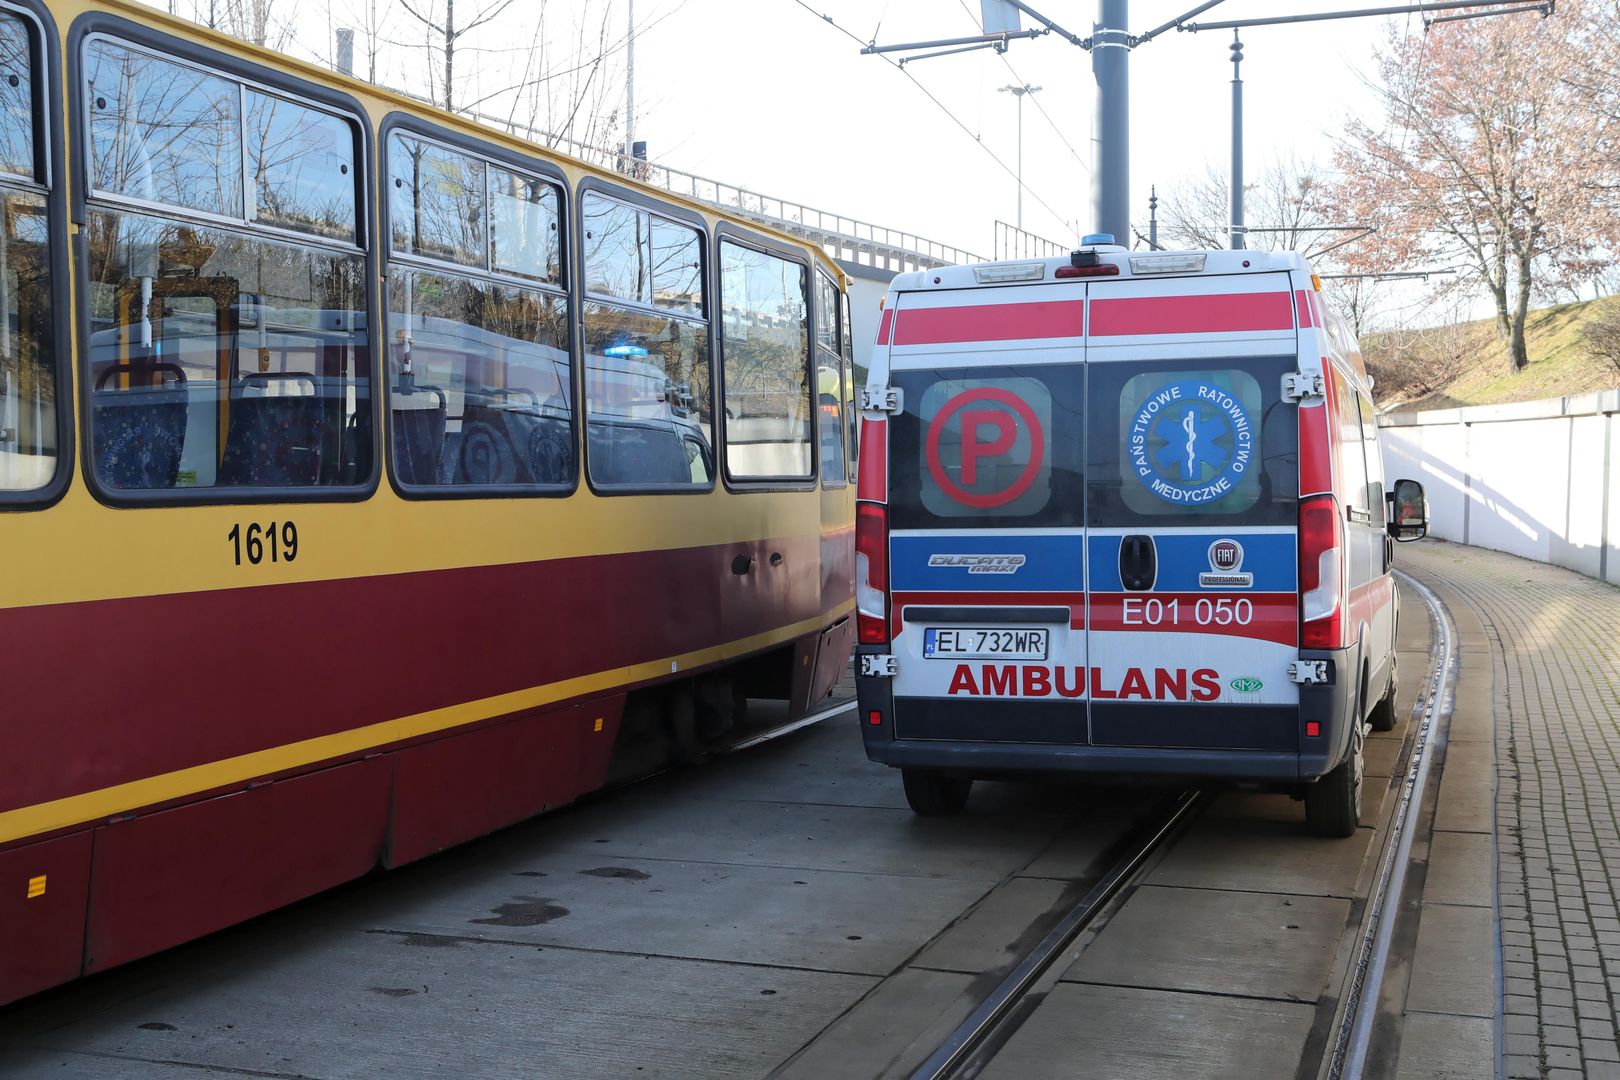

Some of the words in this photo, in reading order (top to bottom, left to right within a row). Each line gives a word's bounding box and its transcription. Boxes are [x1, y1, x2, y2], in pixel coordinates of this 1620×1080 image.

[1130, 386, 1181, 477] PAŃSTWOWE
[1198, 386, 1251, 473] RATOWNICTWO
[961, 410, 1017, 485] P
[1151, 477, 1231, 501] MEDYCZNE
[228, 520, 299, 566] 1619
[1217, 548, 1234, 563] FIAT
[929, 554, 1025, 566] DUCATO
[1122, 598, 1179, 625] E01
[1194, 598, 1253, 625] 050
[938, 632, 967, 652] EL
[976, 632, 1042, 653] 732WR
[948, 664, 1221, 701] AMBULANS
